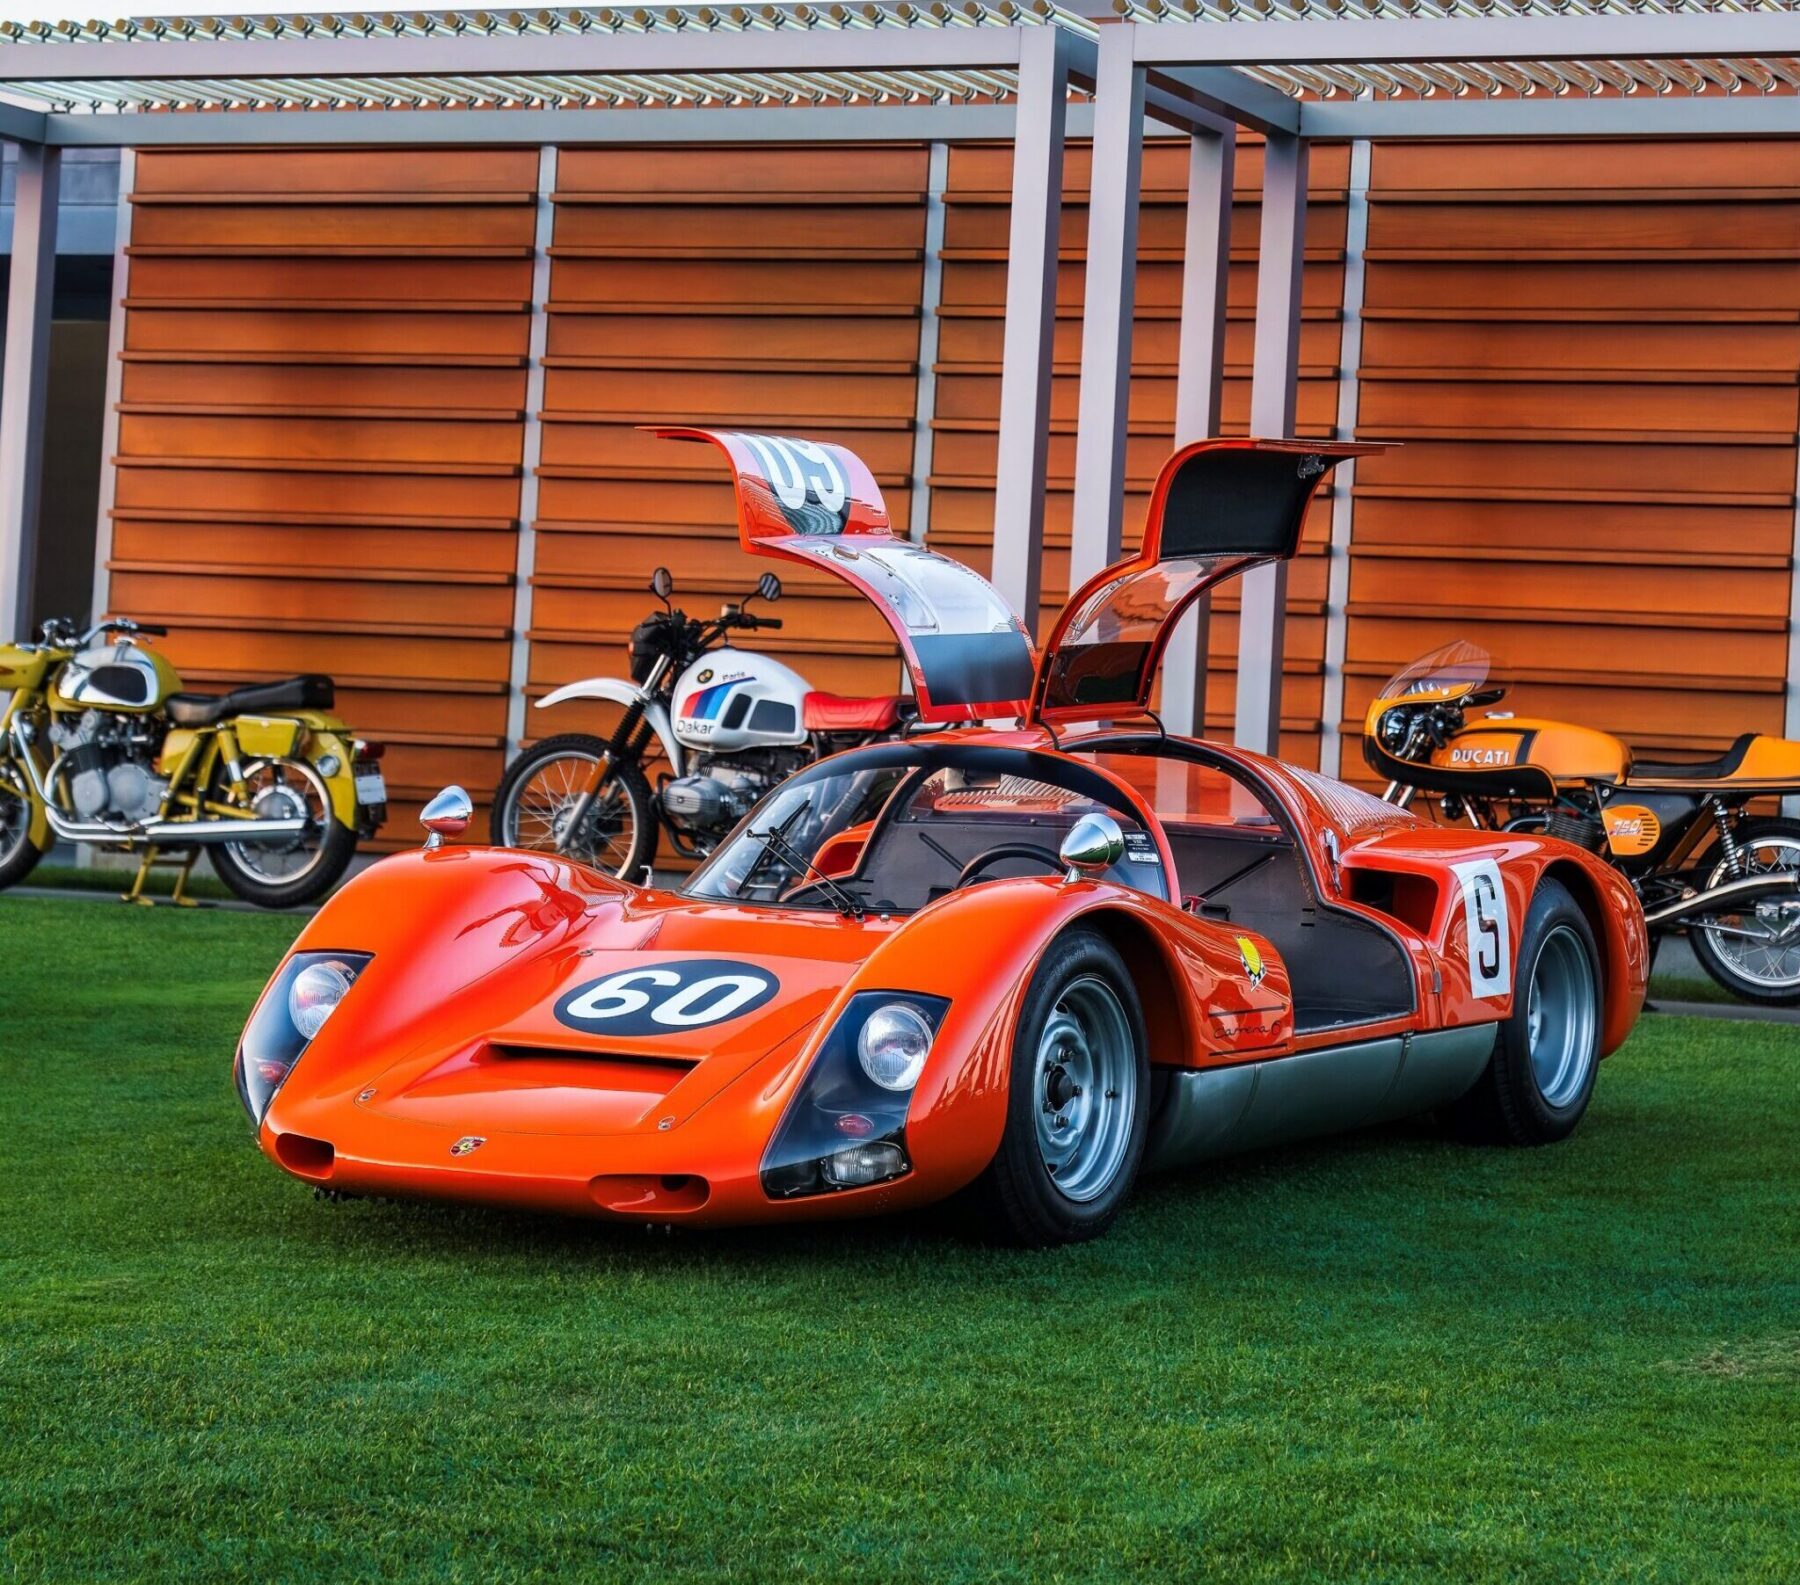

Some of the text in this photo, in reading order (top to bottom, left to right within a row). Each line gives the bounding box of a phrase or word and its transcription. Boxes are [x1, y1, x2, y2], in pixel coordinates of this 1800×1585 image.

[676, 720, 715, 735] Dakar
[1451, 748, 1510, 766] DUCATI
[1614, 819, 1642, 833] 750
[567, 970, 768, 1026] 60
[1270, 1021, 1282, 1036] 6
